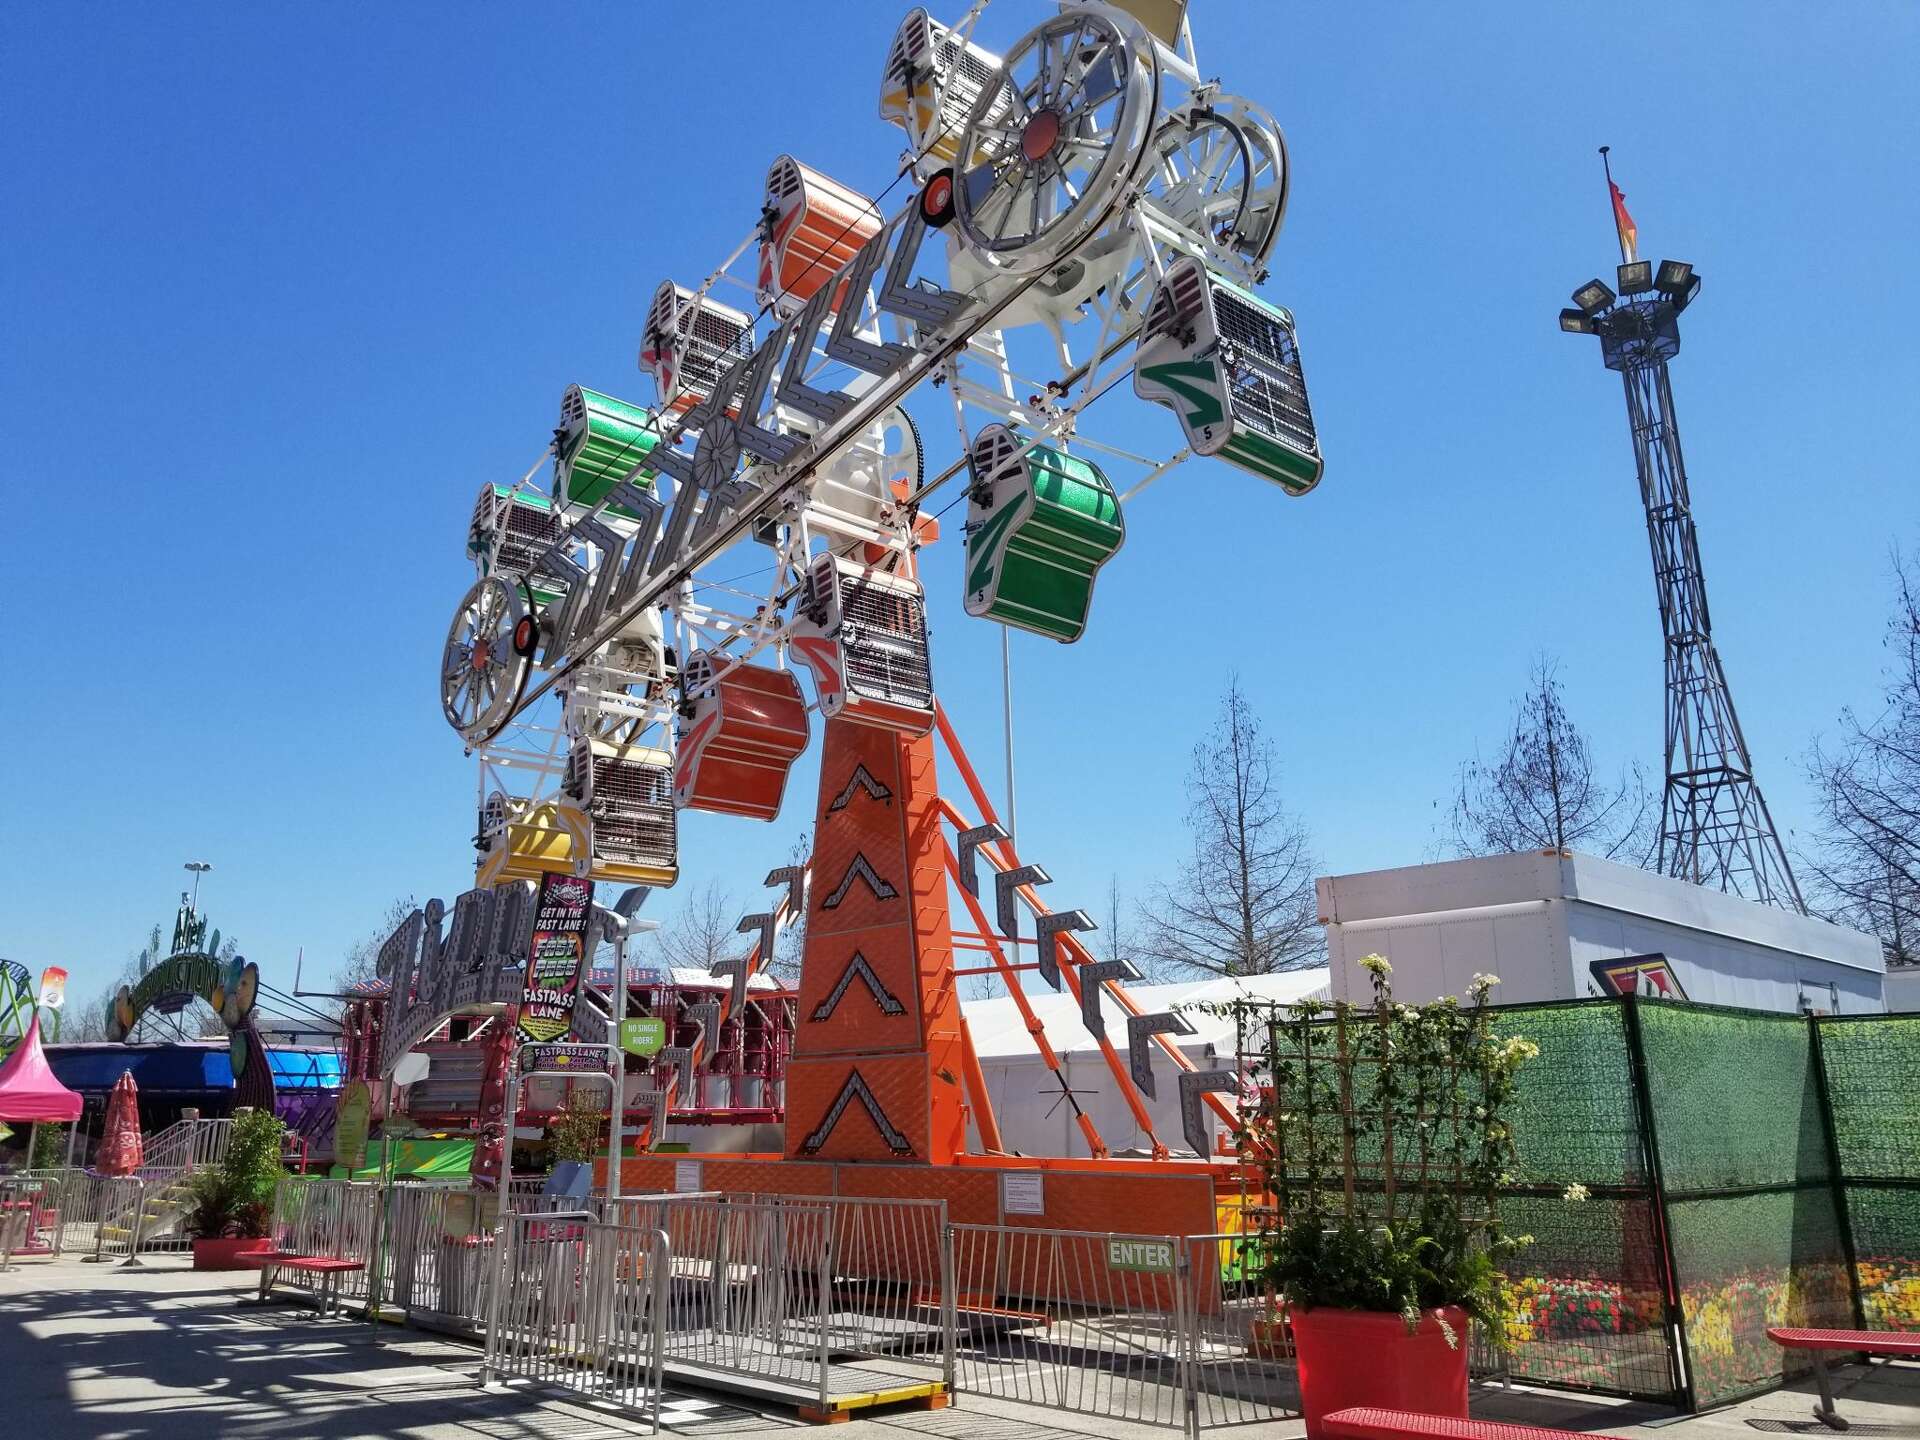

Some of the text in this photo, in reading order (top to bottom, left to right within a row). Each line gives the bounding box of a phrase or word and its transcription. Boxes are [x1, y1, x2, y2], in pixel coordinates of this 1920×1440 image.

[1203, 425, 1212, 440] 5
[978, 590, 984, 602] 5
[540, 907, 583, 918] GET IN THE
[535, 919, 558, 930] FAST
[534, 938, 577, 958] FAST
[532, 959, 578, 979] PASS
[523, 988, 576, 1008] FASTPASS
[530, 1004, 565, 1020] LANE
[628, 1024, 658, 1033] NO SINGLE
[632, 1036, 654, 1045] RIDERS
[534, 1048, 577, 1057] FASTPASS
[1109, 1241, 1172, 1268] ENTER
